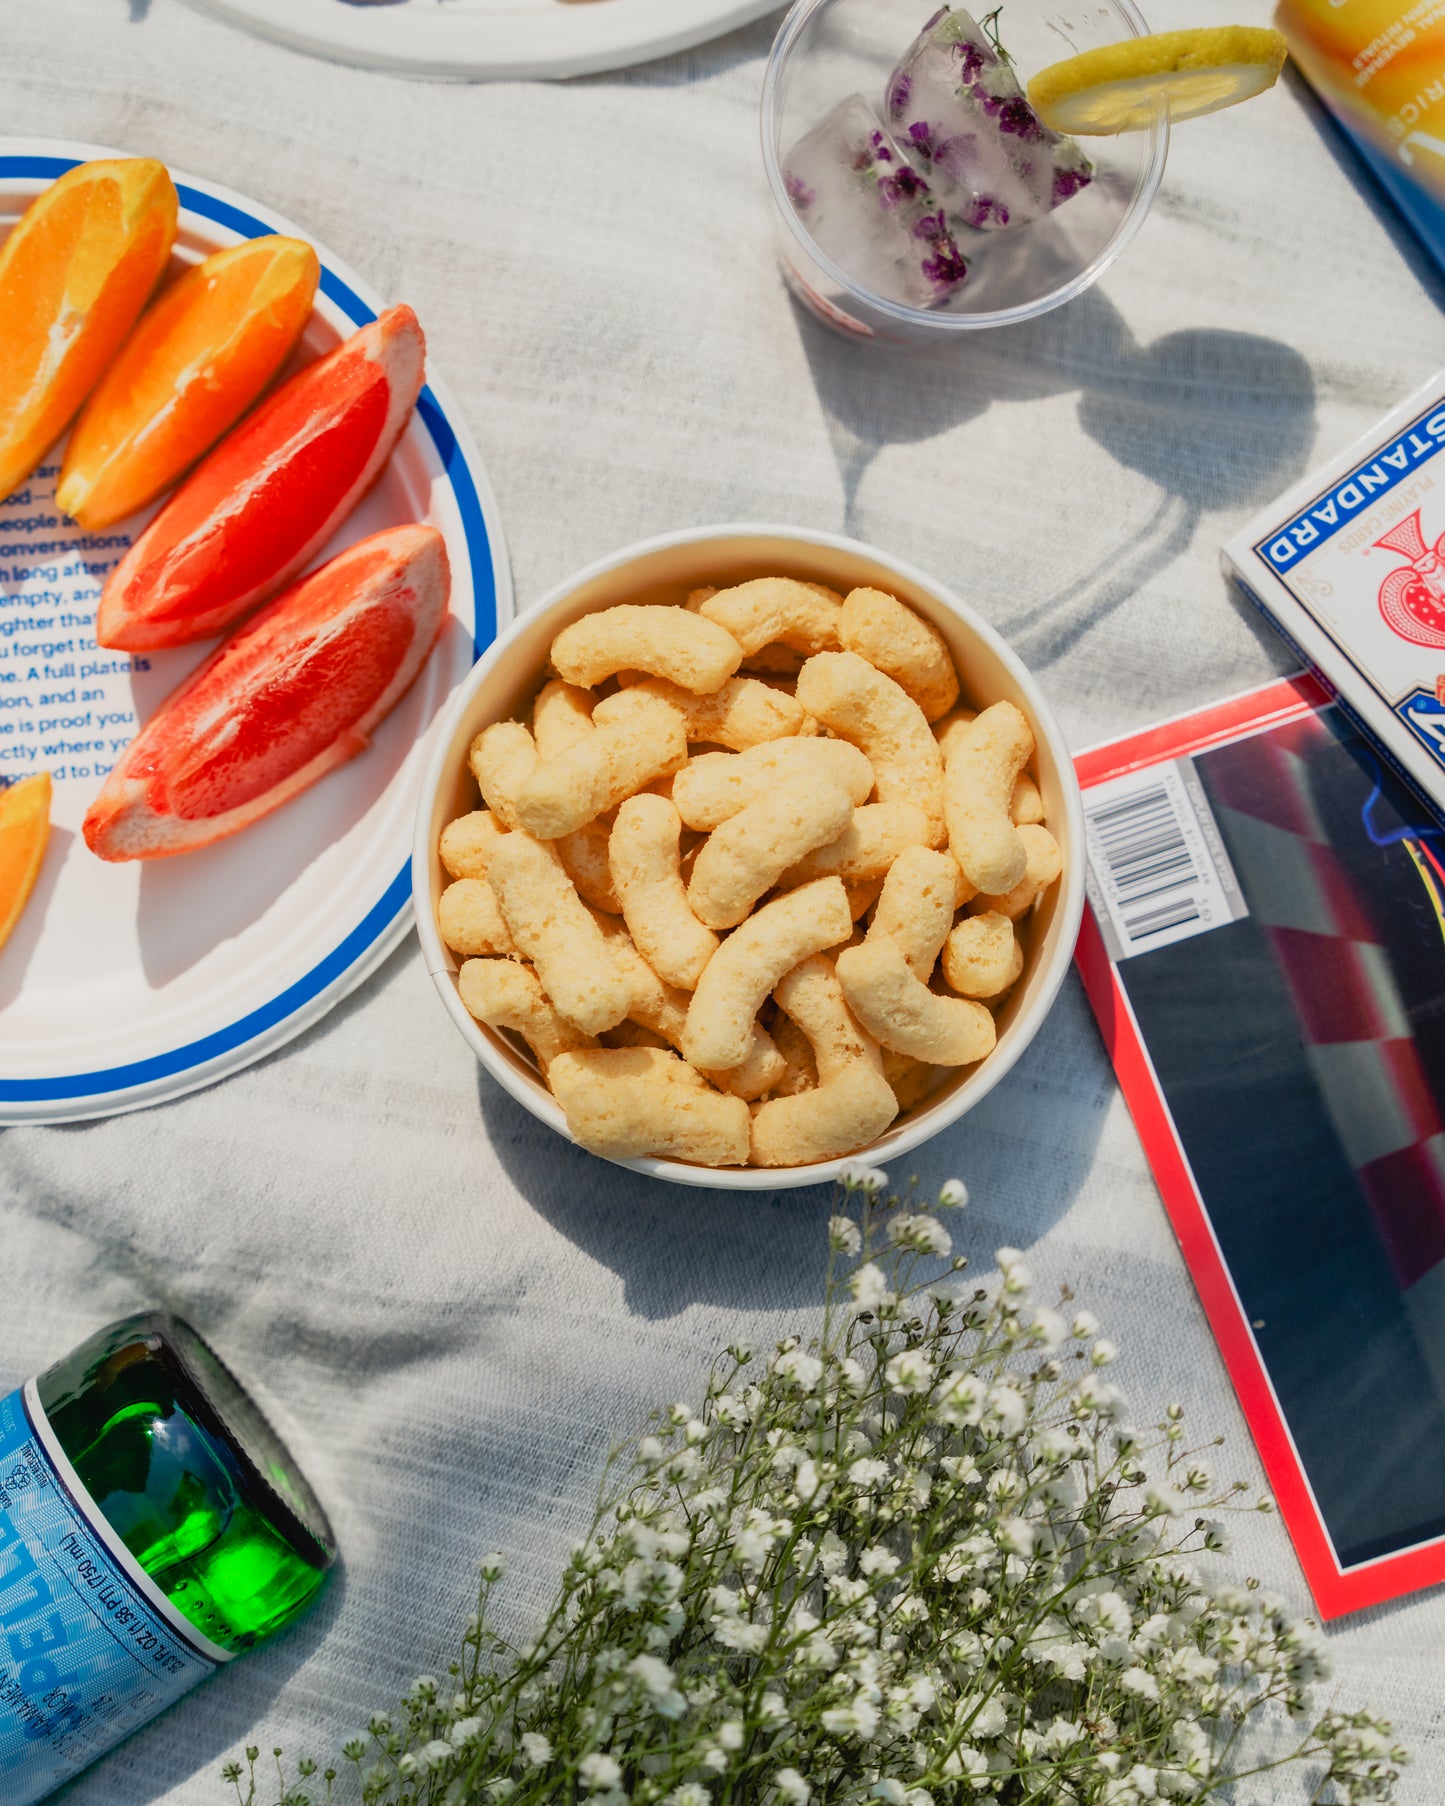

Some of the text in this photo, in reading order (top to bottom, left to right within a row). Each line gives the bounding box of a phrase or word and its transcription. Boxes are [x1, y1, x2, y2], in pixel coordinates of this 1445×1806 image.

[1269, 411, 1445, 563] STANDARD
[0, 513, 57, 533] eople
[1337, 474, 1435, 555] PLAYING CARDS
[0, 534, 131, 557] onversations
[12, 565, 58, 583] long
[63, 561, 109, 577] after
[0, 616, 54, 637] ghter
[13, 640, 74, 658] forget
[27, 667, 40, 681] A
[44, 662, 76, 679] full
[81, 660, 132, 680] plate
[133, 655, 153, 673] is
[39, 687, 76, 706] and
[81, 688, 105, 702] an
[19, 718, 35, 733] is
[39, 711, 92, 734] proof
[97, 712, 134, 729] you
[0, 744, 37, 761] ctly
[42, 740, 105, 756] where
[71, 766, 91, 779] to
[58, 1531, 86, 1561] mL)
[77, 1559, 108, 1590] (750
[98, 1584, 120, 1611] PT)
[114, 1606, 147, 1636] (1.58
[136, 1630, 158, 1651] OZ
[152, 1644, 170, 1662] FL
